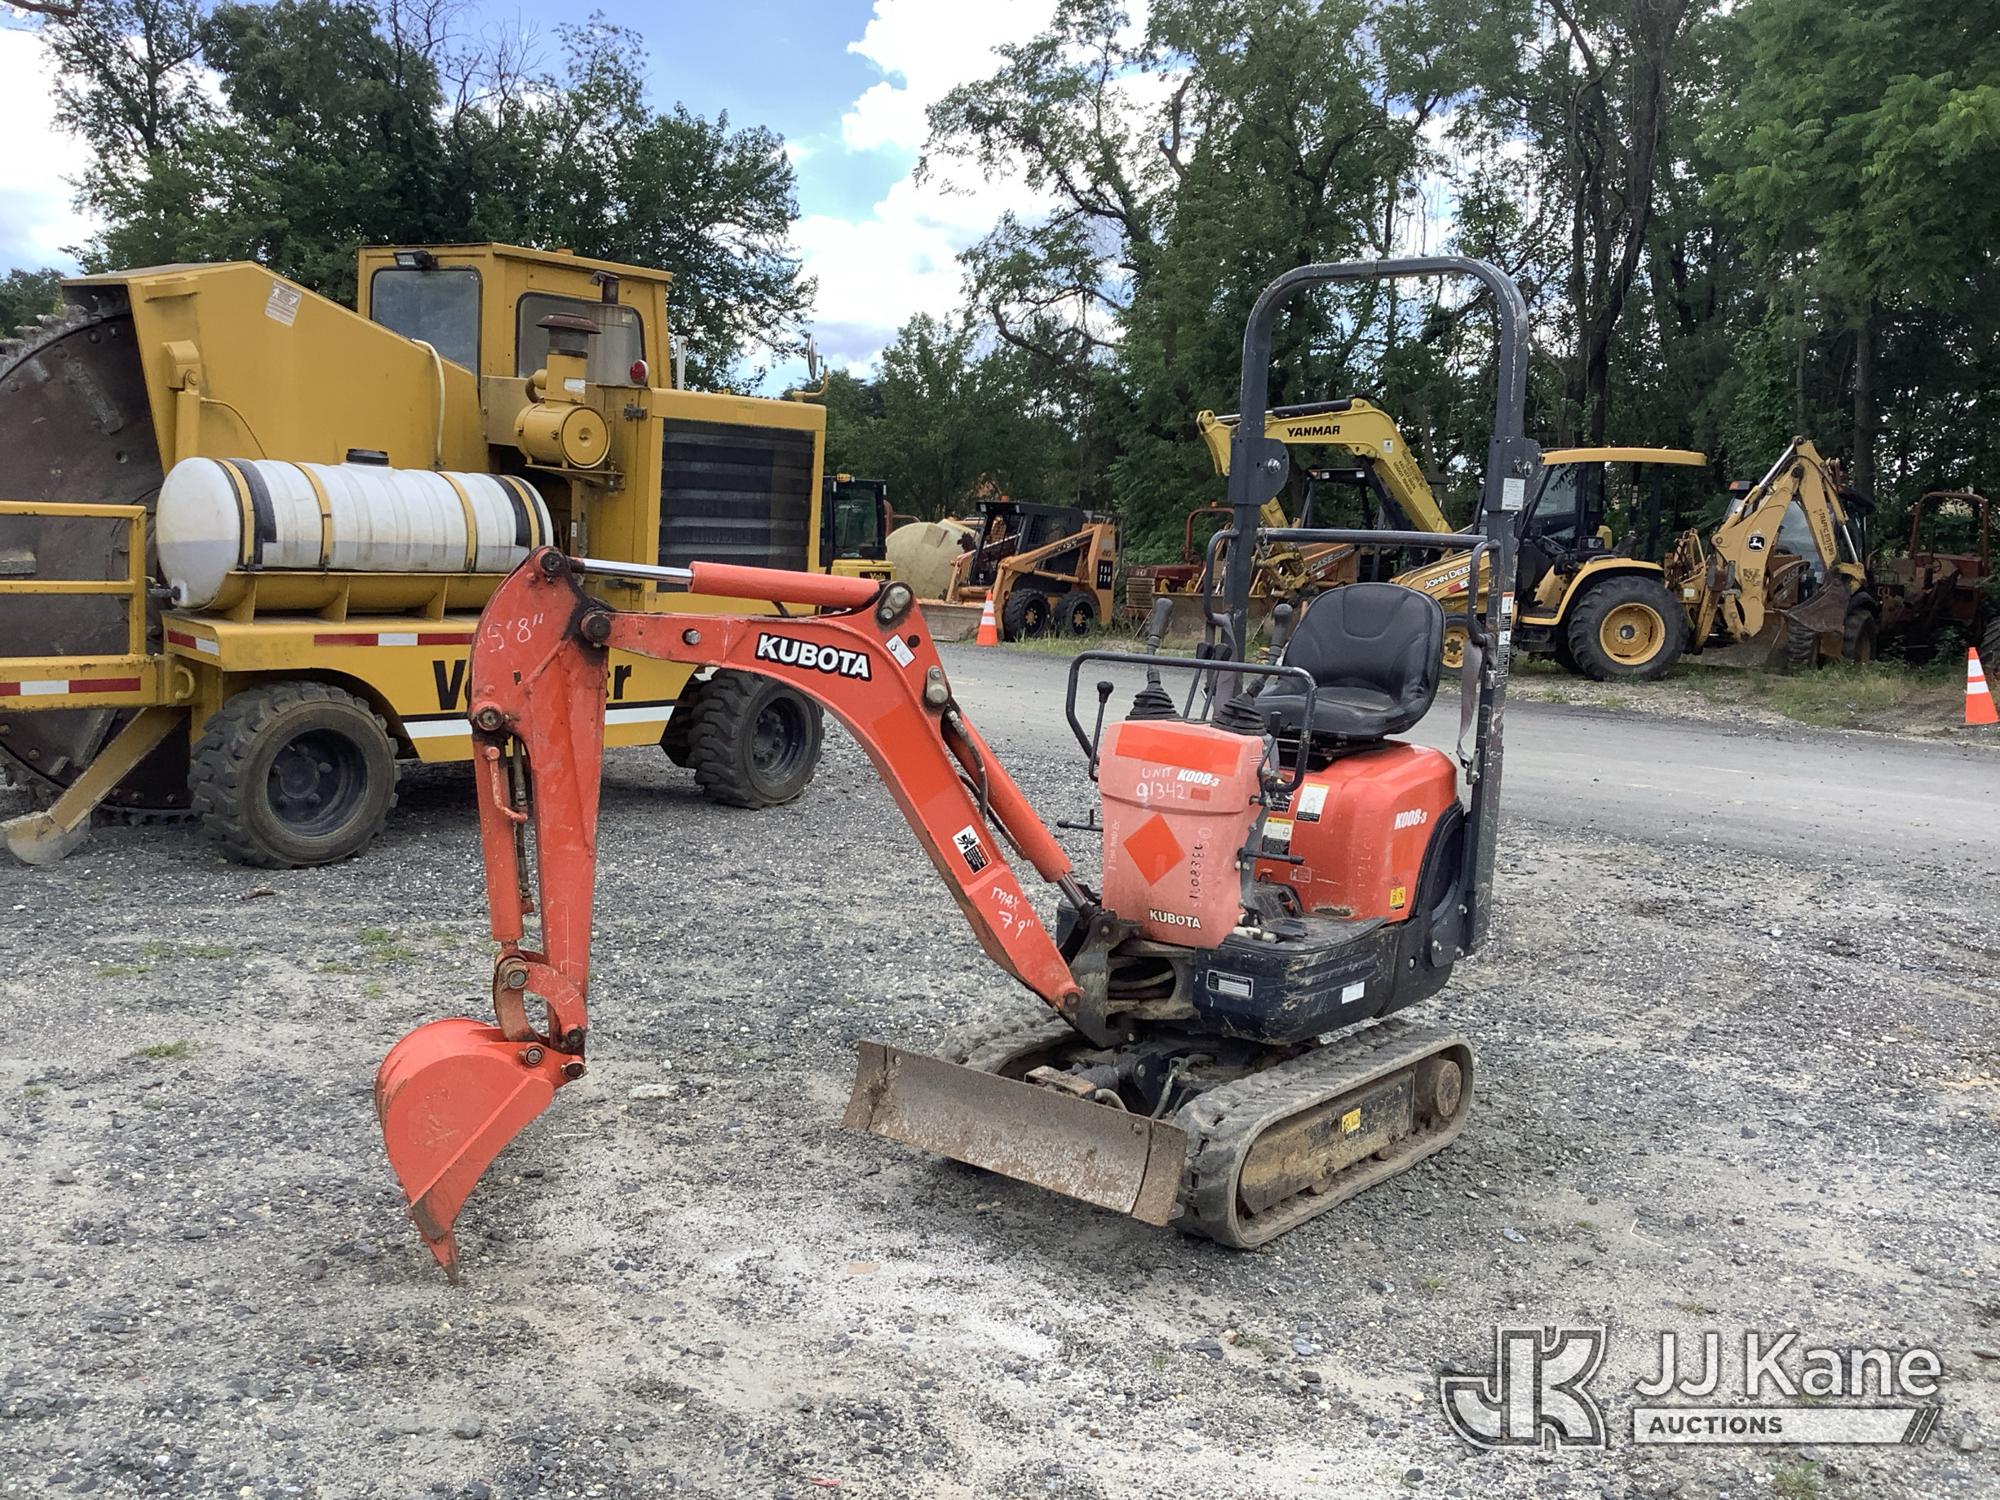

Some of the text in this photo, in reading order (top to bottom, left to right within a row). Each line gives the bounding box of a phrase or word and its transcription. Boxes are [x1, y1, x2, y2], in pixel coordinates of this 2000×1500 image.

[1287, 425, 1340, 437] YANMAR
[1311, 553, 1334, 571] CASE
[1424, 564, 1471, 590] JOHN DEE
[755, 633, 871, 679] KUBOTA
[1142, 767, 1174, 779] UNIT
[1176, 768, 1220, 787] K008-3
[1394, 808, 1427, 830] K008-3
[1149, 910, 1201, 929] KUBOTA
